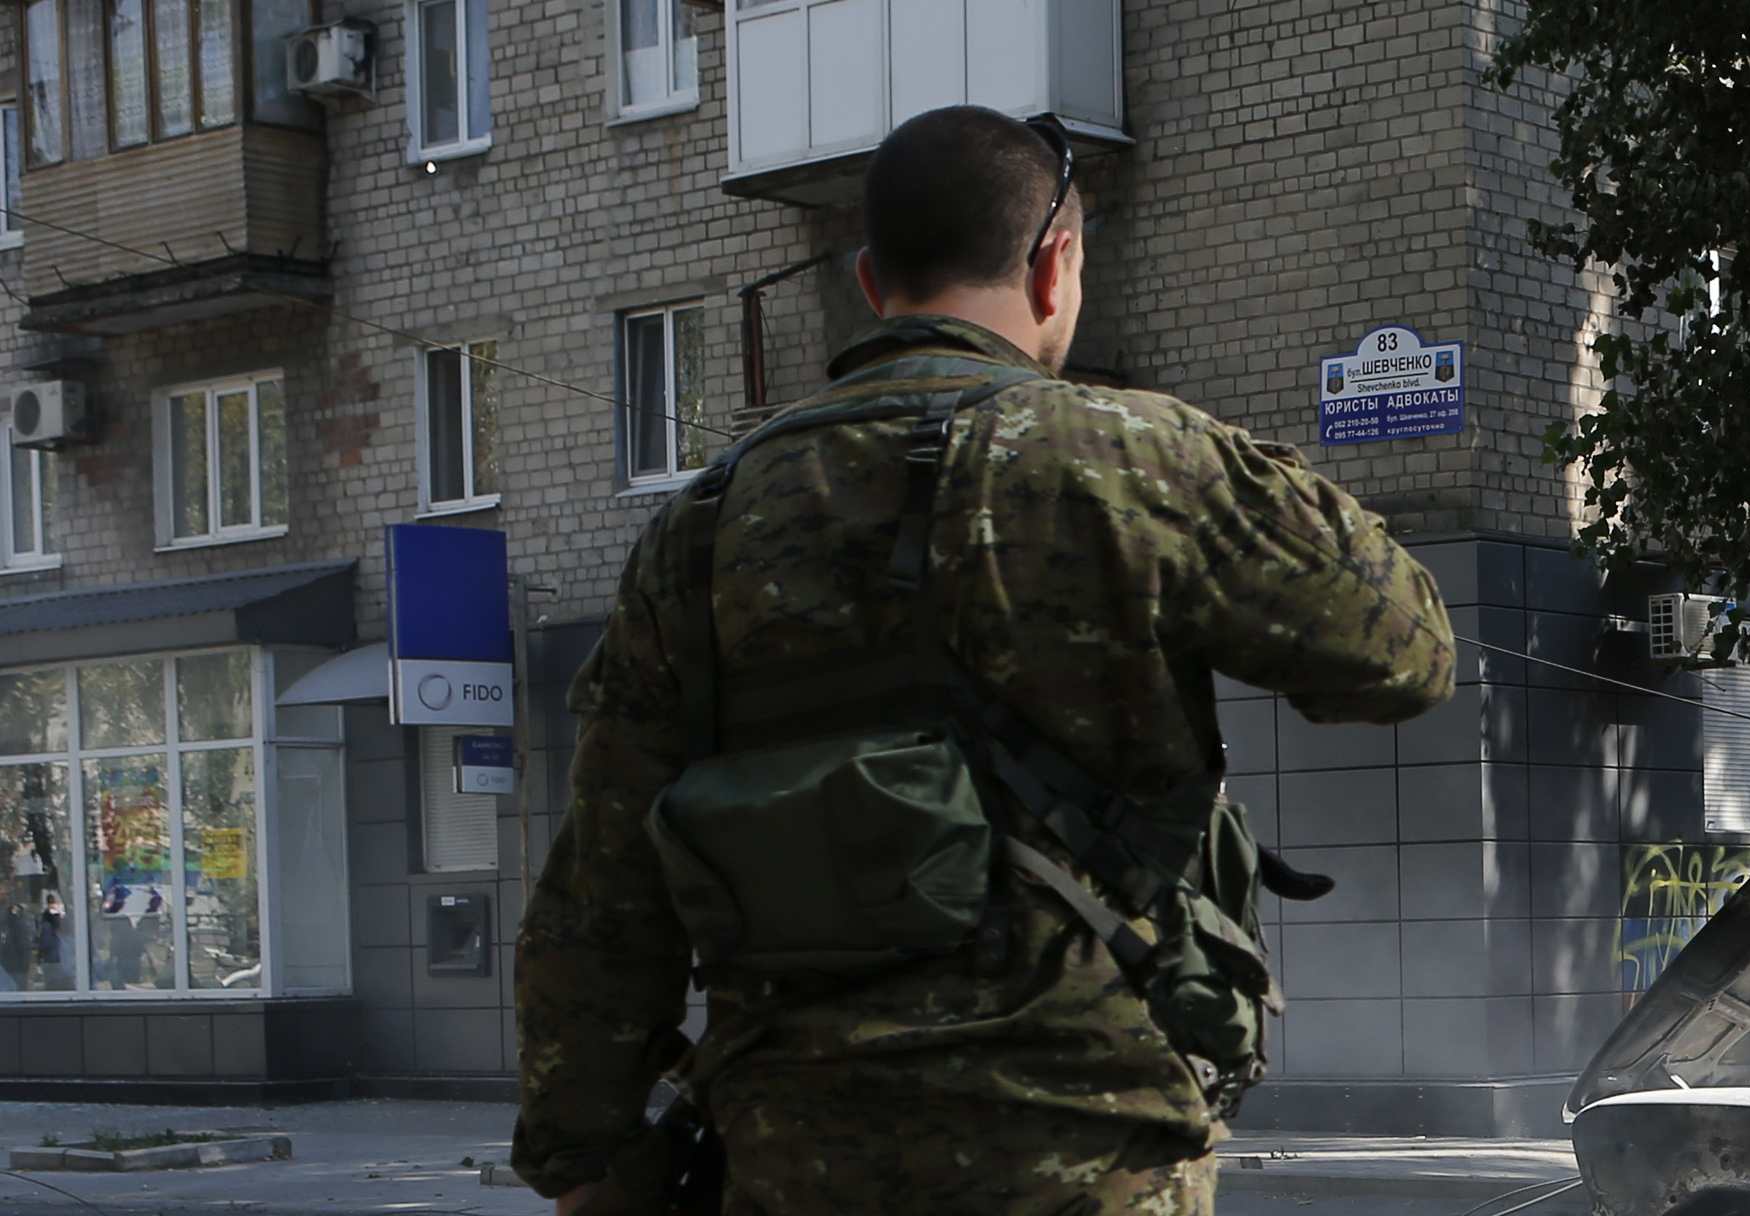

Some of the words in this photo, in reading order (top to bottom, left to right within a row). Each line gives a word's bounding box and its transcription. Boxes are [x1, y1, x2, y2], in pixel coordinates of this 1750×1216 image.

[1377, 332, 1398, 352] 83
[1362, 354, 1432, 376] ШЕВЧЕНКО
[1357, 380, 1401, 394] Shevchenko
[1324, 397, 1379, 415] ЮРИСТЫ
[1387, 389, 1459, 409] АДВОКАТЫ
[463, 684, 503, 702] FIDO
